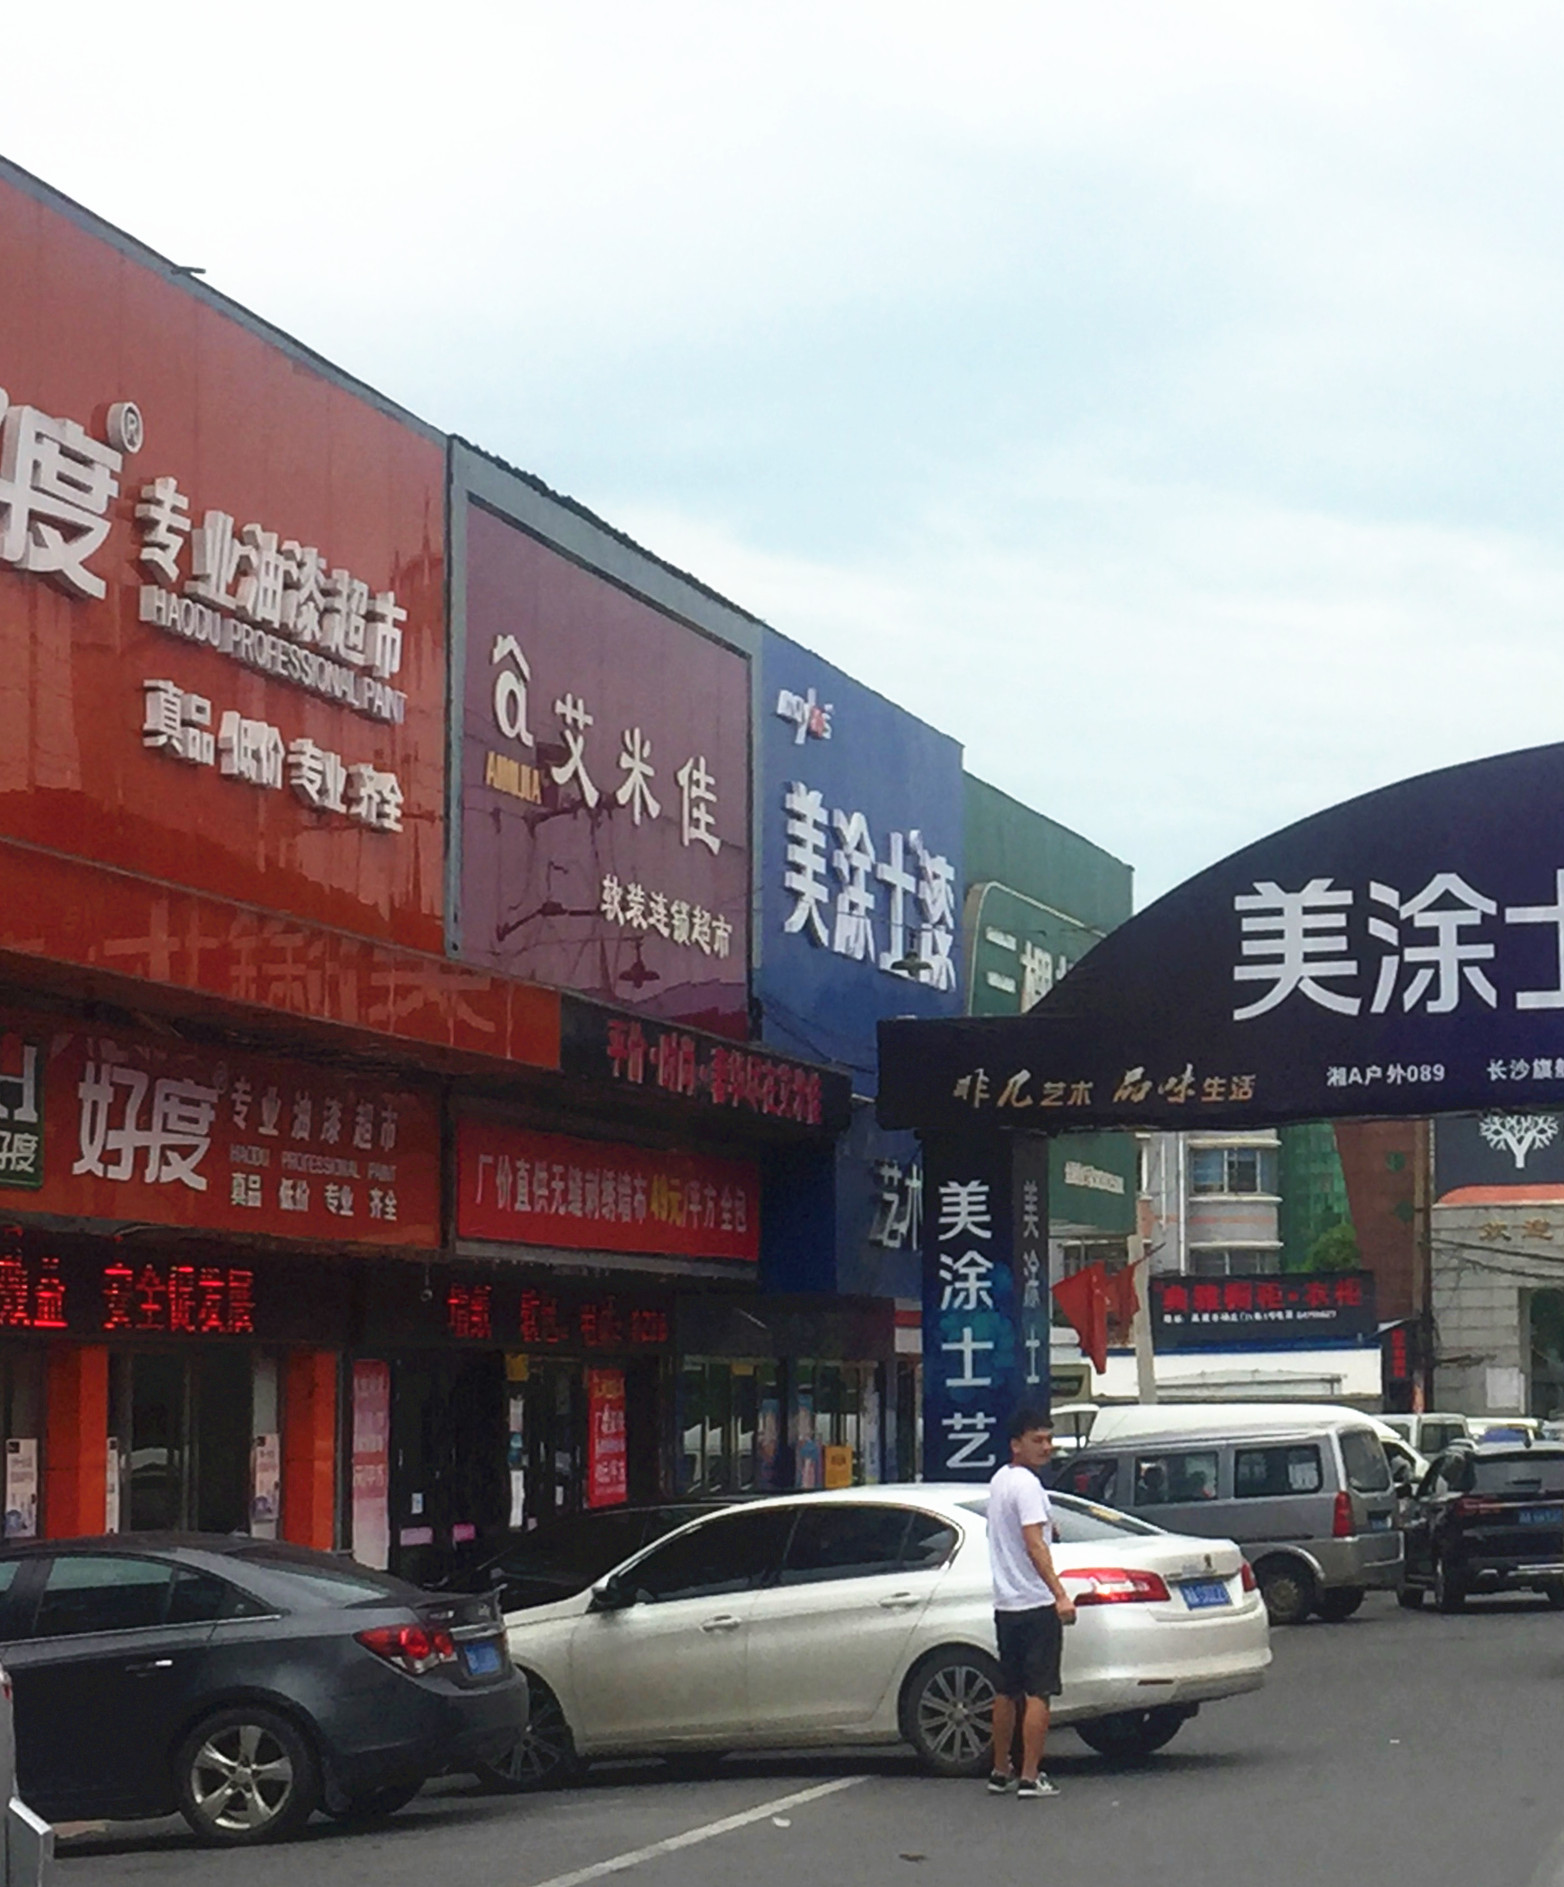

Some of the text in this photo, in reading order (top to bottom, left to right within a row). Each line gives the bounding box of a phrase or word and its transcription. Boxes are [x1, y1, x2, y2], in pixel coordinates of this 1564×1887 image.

[0, 386, 123, 600] 度
[135, 476, 407, 678] 专业油漆超市
[140, 584, 222, 650] HAODU
[551, 693, 722, 856] 艾米佳
[601, 873, 733, 959] 软装连锁超市
[783, 780, 957, 992] 美涂士漆
[72, 1061, 218, 1191] 好度
[231, 1076, 398, 1153] 专业油漆超市
[1326, 1064, 1446, 1088] 湘A户外089
[324, 1182, 354, 1217] 专业
